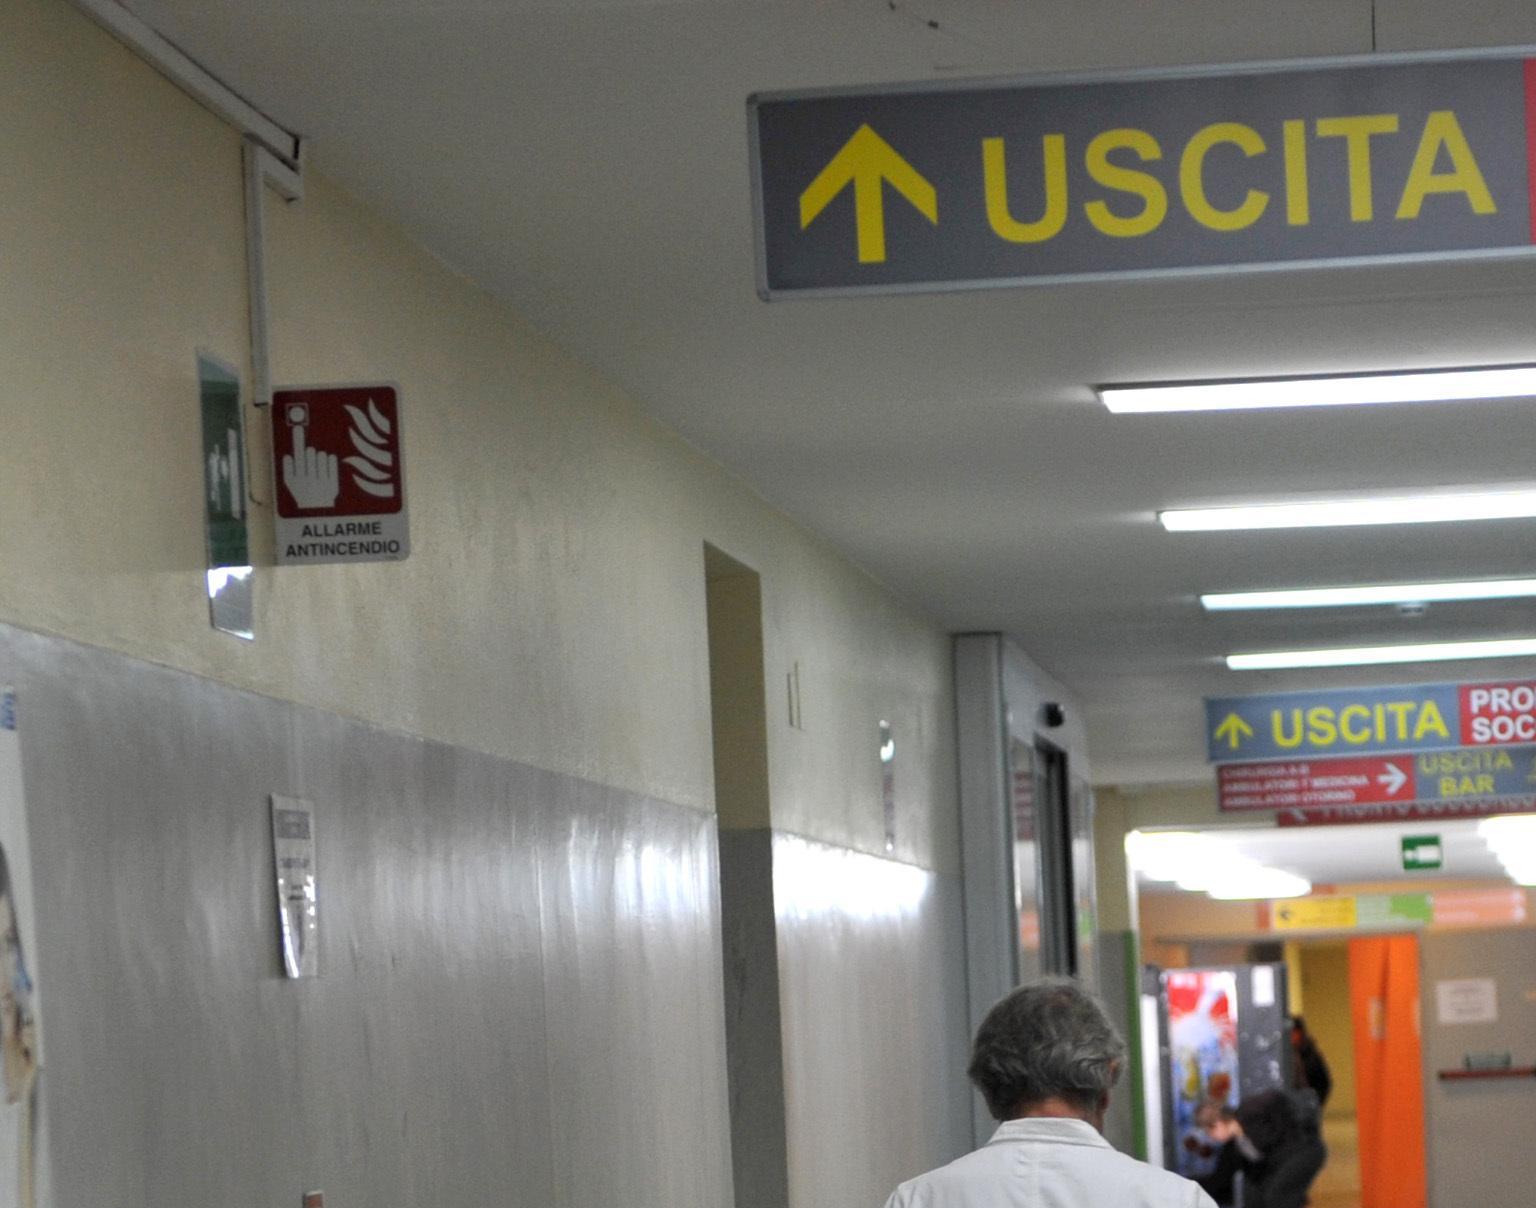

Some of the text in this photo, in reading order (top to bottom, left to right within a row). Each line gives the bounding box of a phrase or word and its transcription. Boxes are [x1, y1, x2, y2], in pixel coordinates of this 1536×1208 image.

[981, 110, 1498, 243] USCITA
[302, 522, 381, 537] ALLARME
[286, 540, 399, 556] ANTINCENDIO
[1270, 699, 1449, 748] USCITA
[1417, 750, 1514, 776] USCITA
[1439, 773, 1495, 798] BAR
